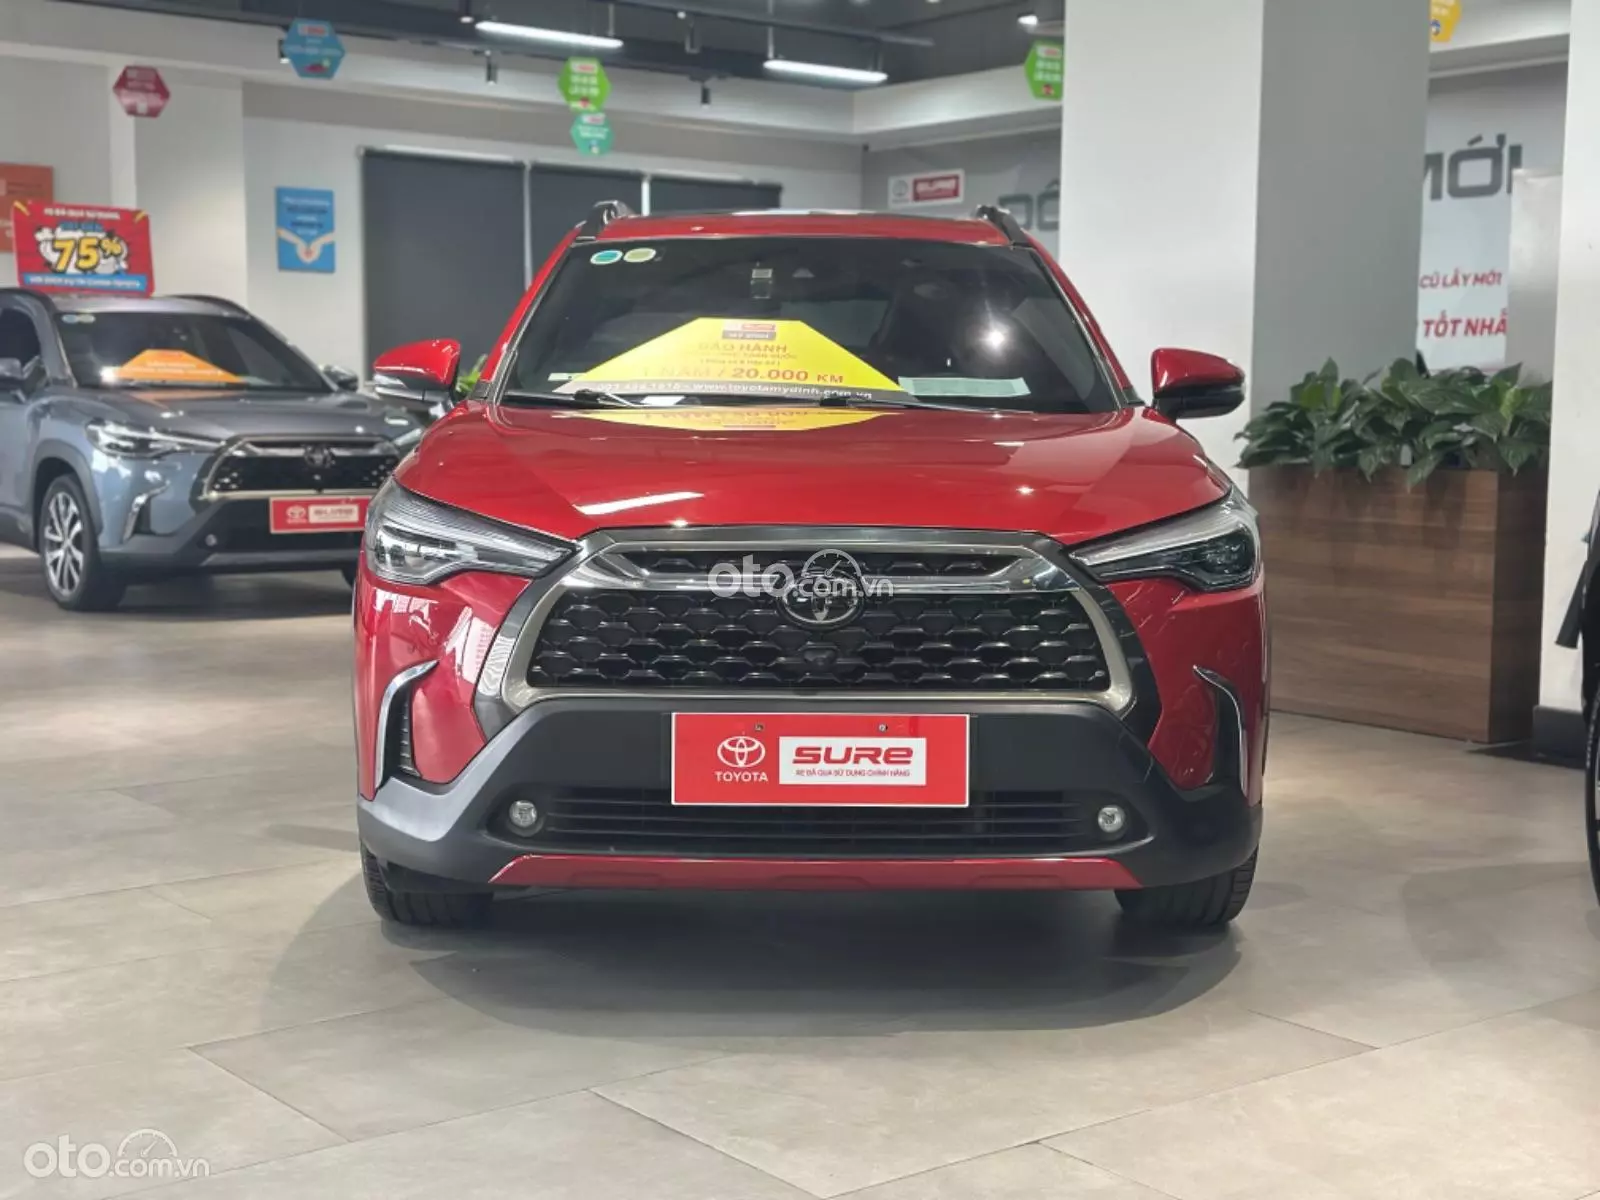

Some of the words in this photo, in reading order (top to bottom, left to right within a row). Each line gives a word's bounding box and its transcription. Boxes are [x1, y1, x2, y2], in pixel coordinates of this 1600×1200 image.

[52, 236, 123, 273] 75%
[1423, 309, 1462, 338] TỐT
[731, 368, 809, 381] 20.000
[816, 373, 844, 383] KM
[714, 771, 769, 783] TOYOTA
